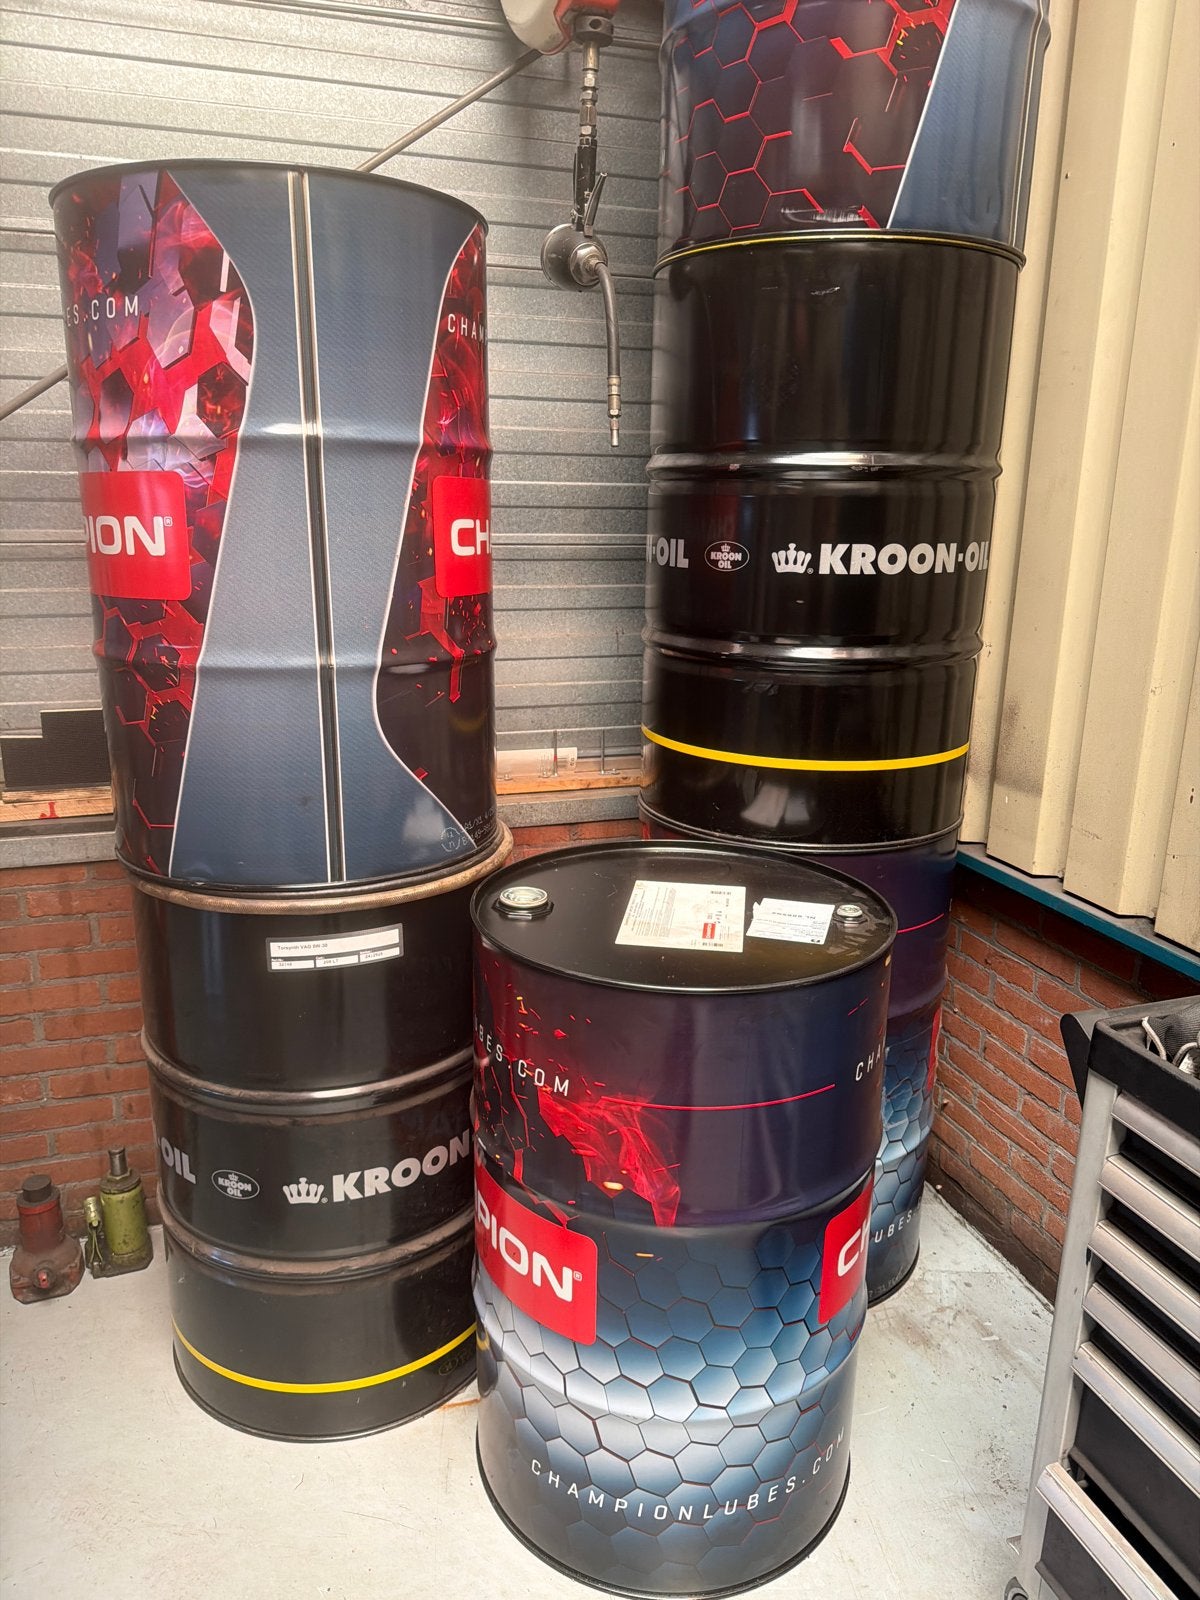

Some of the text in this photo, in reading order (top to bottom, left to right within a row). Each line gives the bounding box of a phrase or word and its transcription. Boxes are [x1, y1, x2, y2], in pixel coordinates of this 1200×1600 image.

[710, 551, 742, 562] KROON
[717, 559, 733, 569] OIL
[217, 1176, 252, 1192] KROON
[227, 1187, 243, 1198] OIL
[530, 1426, 844, 1521] CHAMPIONLUBES.COM
